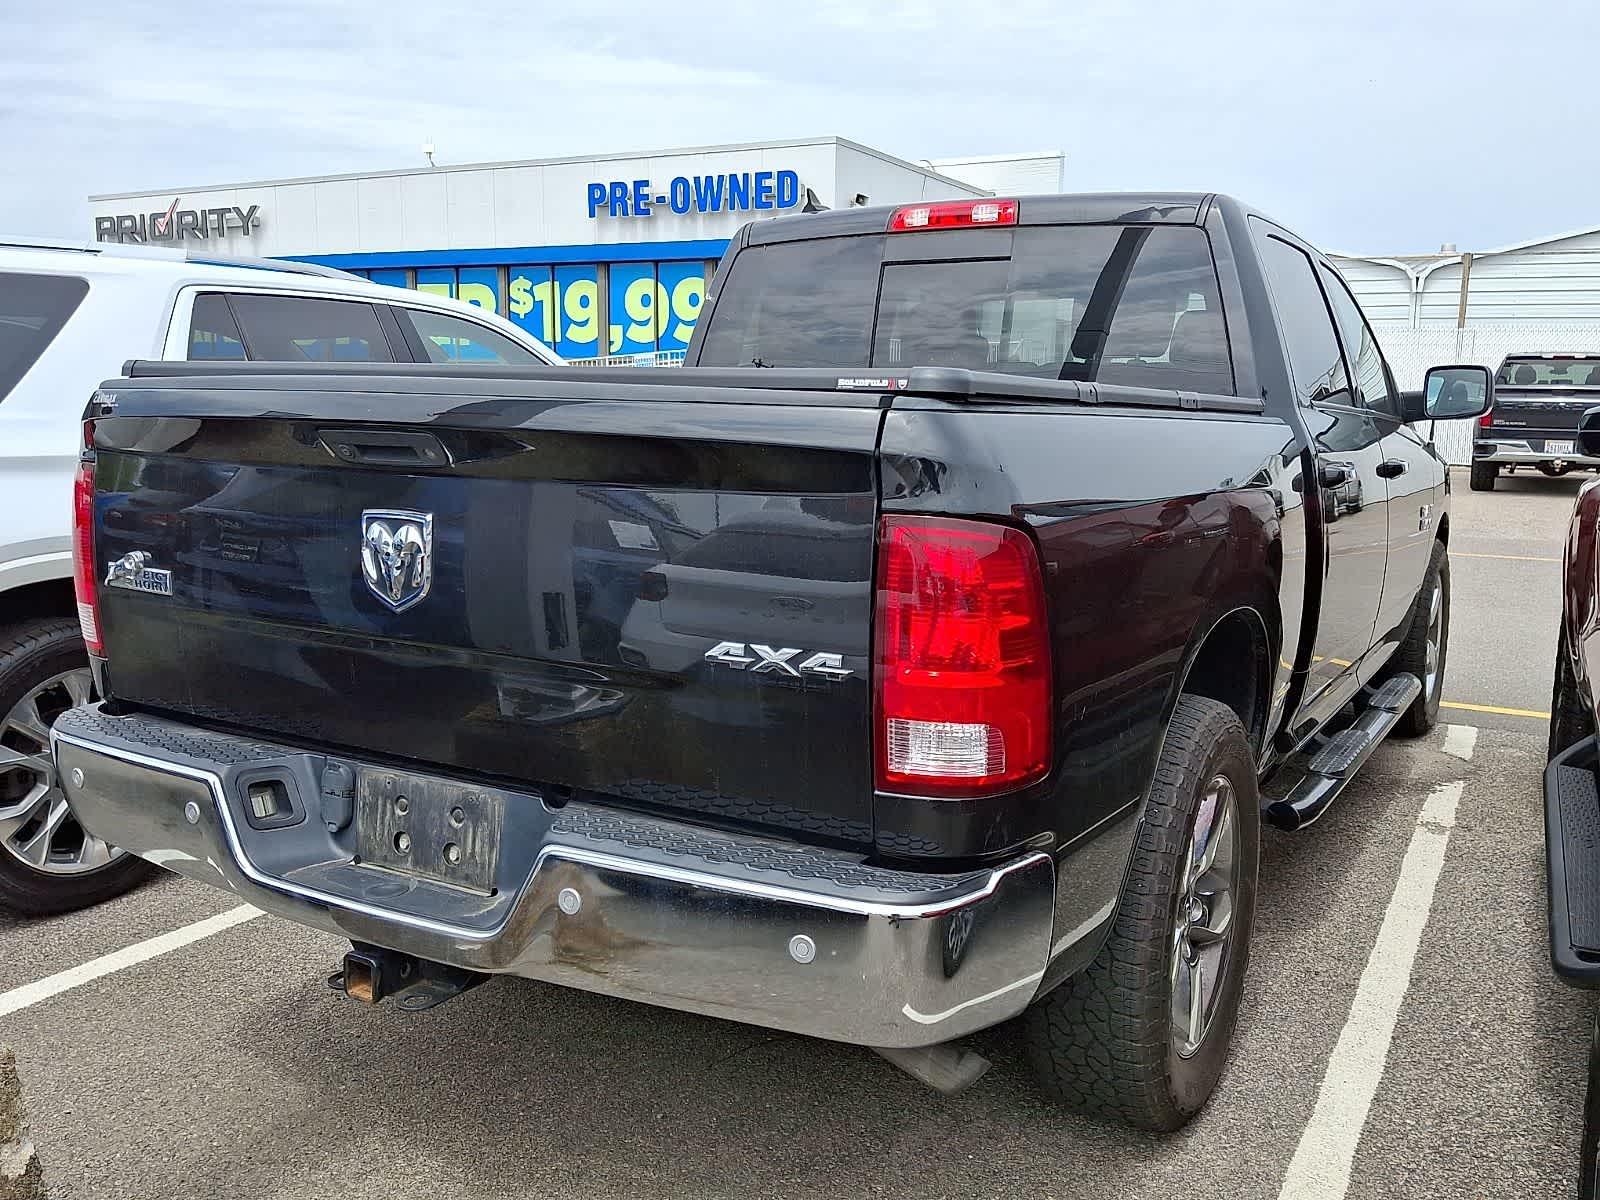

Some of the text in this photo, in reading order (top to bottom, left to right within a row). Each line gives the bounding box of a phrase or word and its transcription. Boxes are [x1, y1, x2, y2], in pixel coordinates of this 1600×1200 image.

[587, 170, 799, 218] PRE-OWNED
[95, 204, 259, 243] PRIORITY
[134, 579, 169, 593] HORN
[143, 570, 163, 582] BIG
